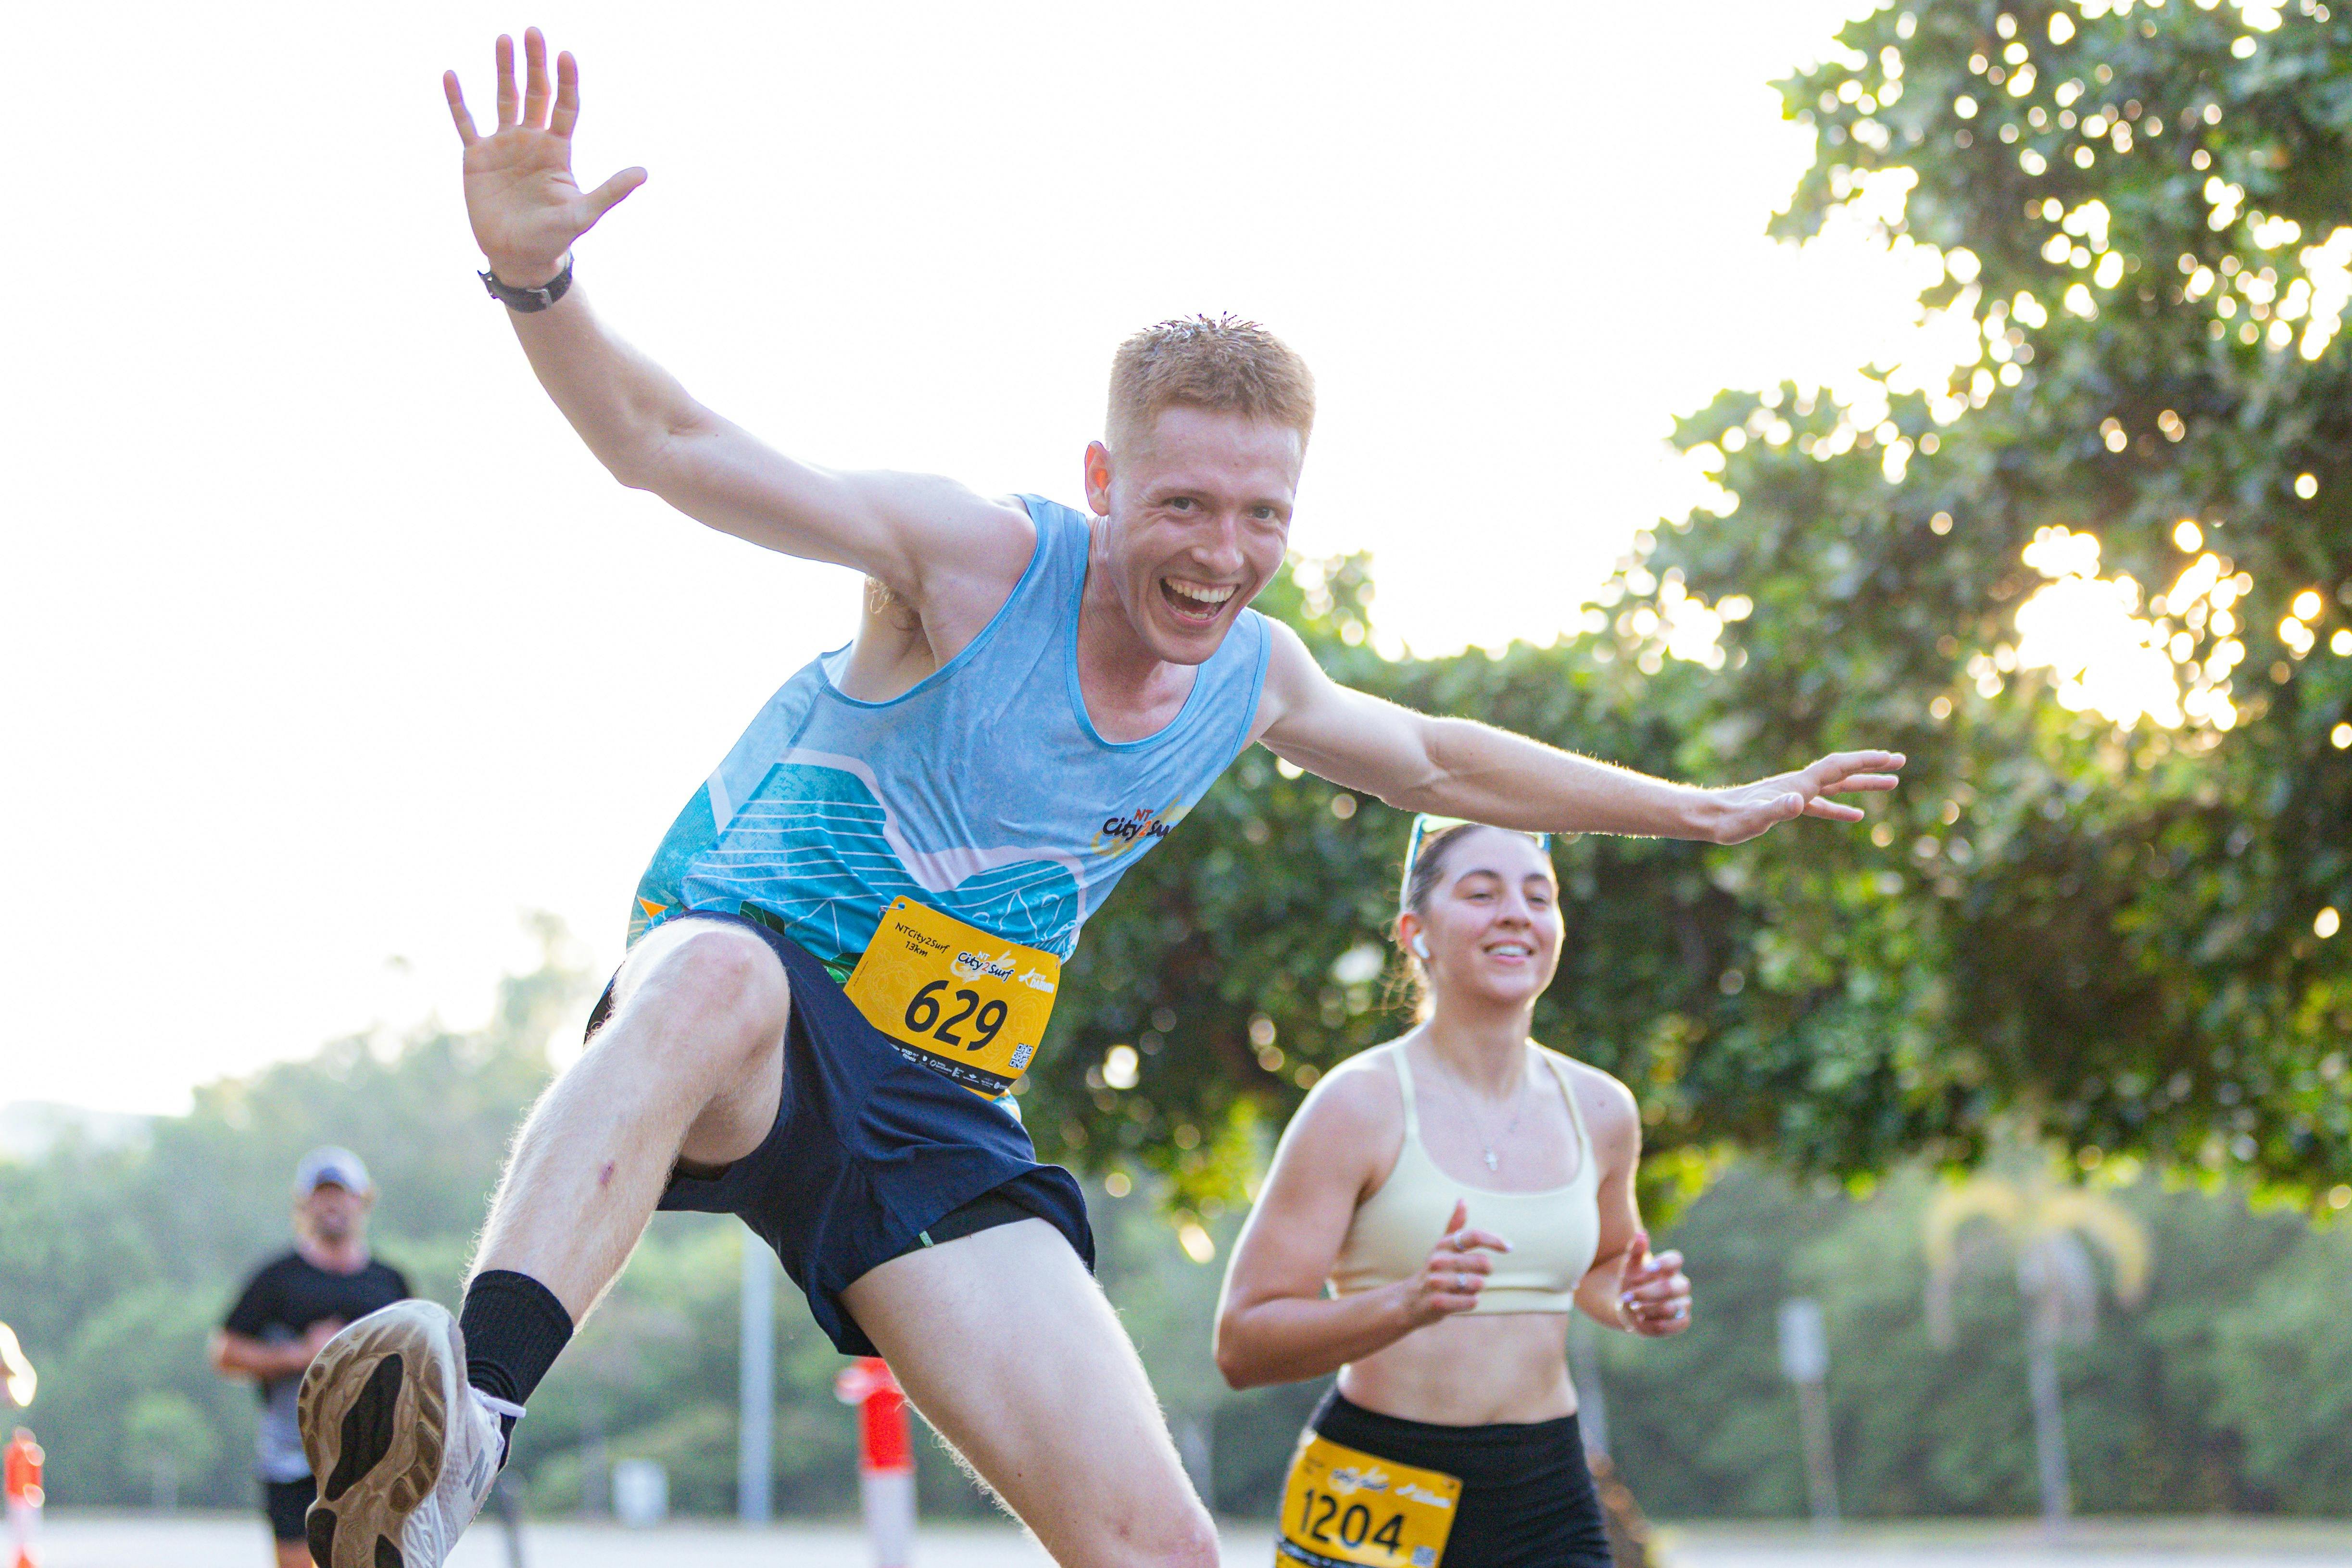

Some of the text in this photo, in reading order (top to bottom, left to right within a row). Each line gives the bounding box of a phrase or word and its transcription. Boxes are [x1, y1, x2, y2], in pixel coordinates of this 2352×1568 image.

[1133, 808, 1154, 821] NT
[1103, 817, 1170, 842] City2Su
[895, 922, 950, 953] NTCity2Surf
[906, 941, 928, 957] 13km
[957, 952, 1015, 982] City2Surf
[977, 951, 990, 961] NT
[905, 979, 1008, 1052] 629
[1300, 1488, 1404, 1557] 1204
